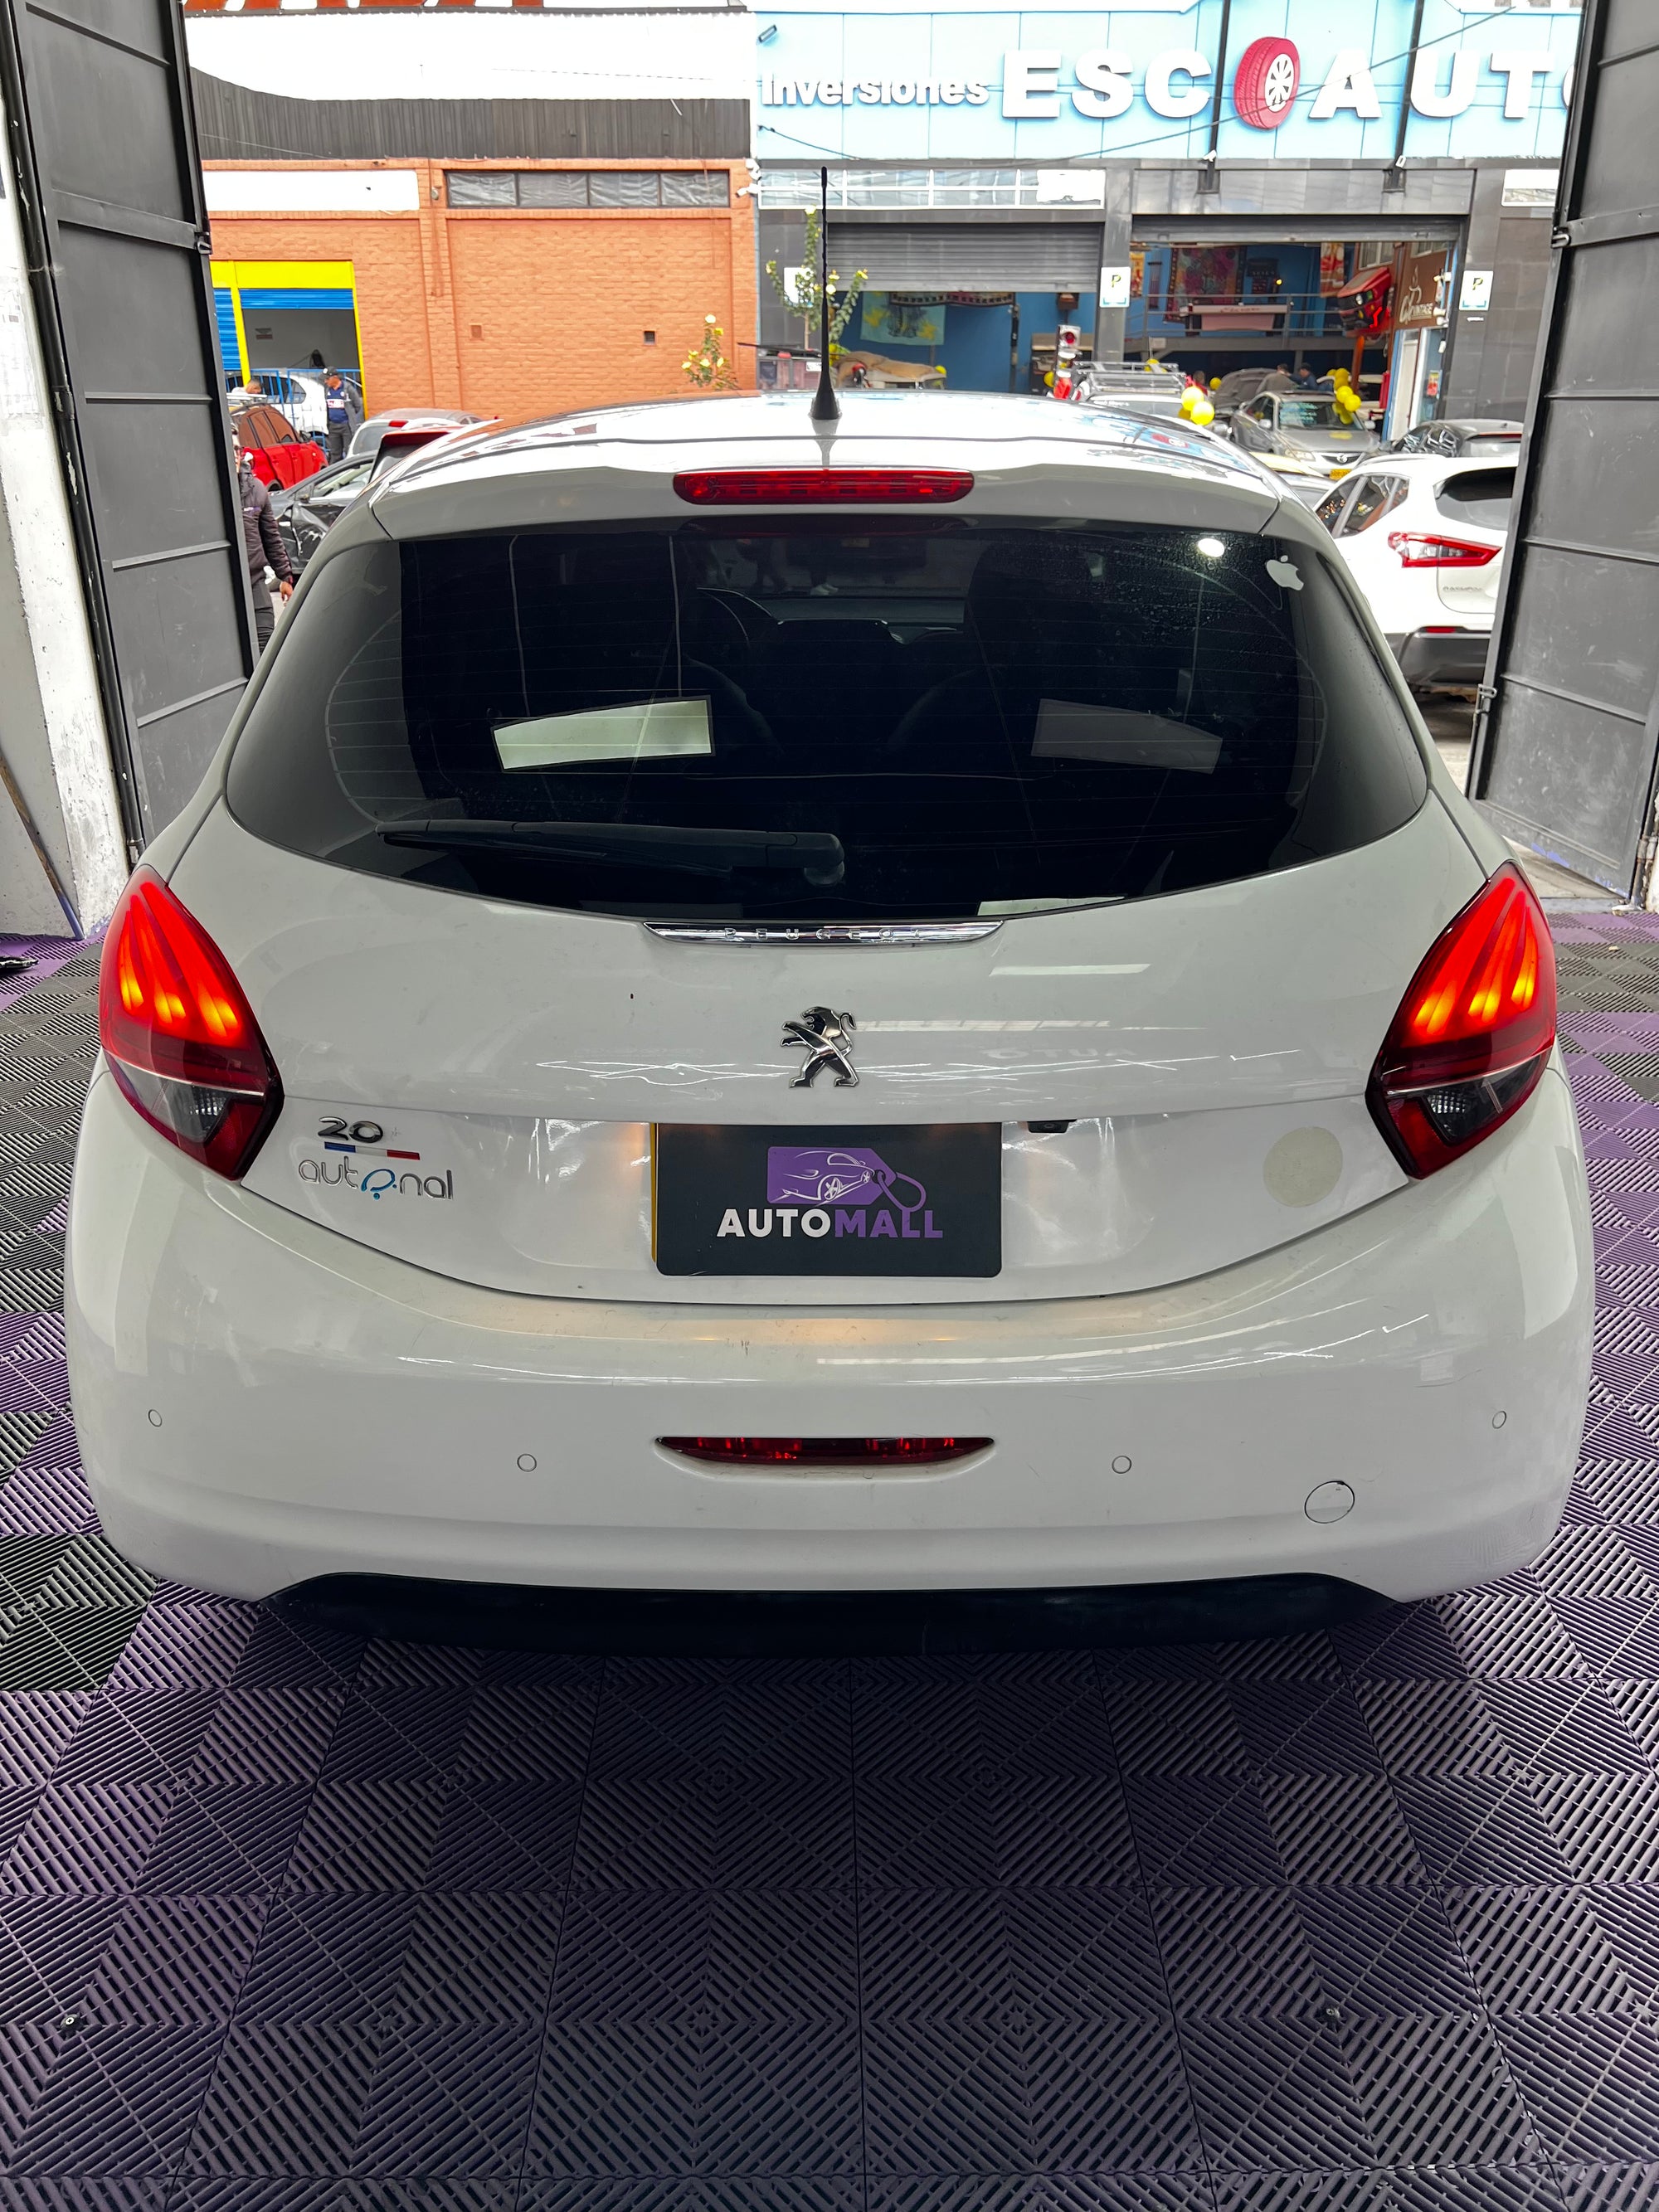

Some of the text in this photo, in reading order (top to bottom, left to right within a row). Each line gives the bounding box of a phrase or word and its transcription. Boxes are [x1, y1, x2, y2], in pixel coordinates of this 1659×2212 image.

[761, 71, 990, 106] Inversiones
[1308, 49, 1574, 119] AUT
[317, 1116, 384, 1144] 20
[716, 1208, 943, 1238] AUTOMALL
